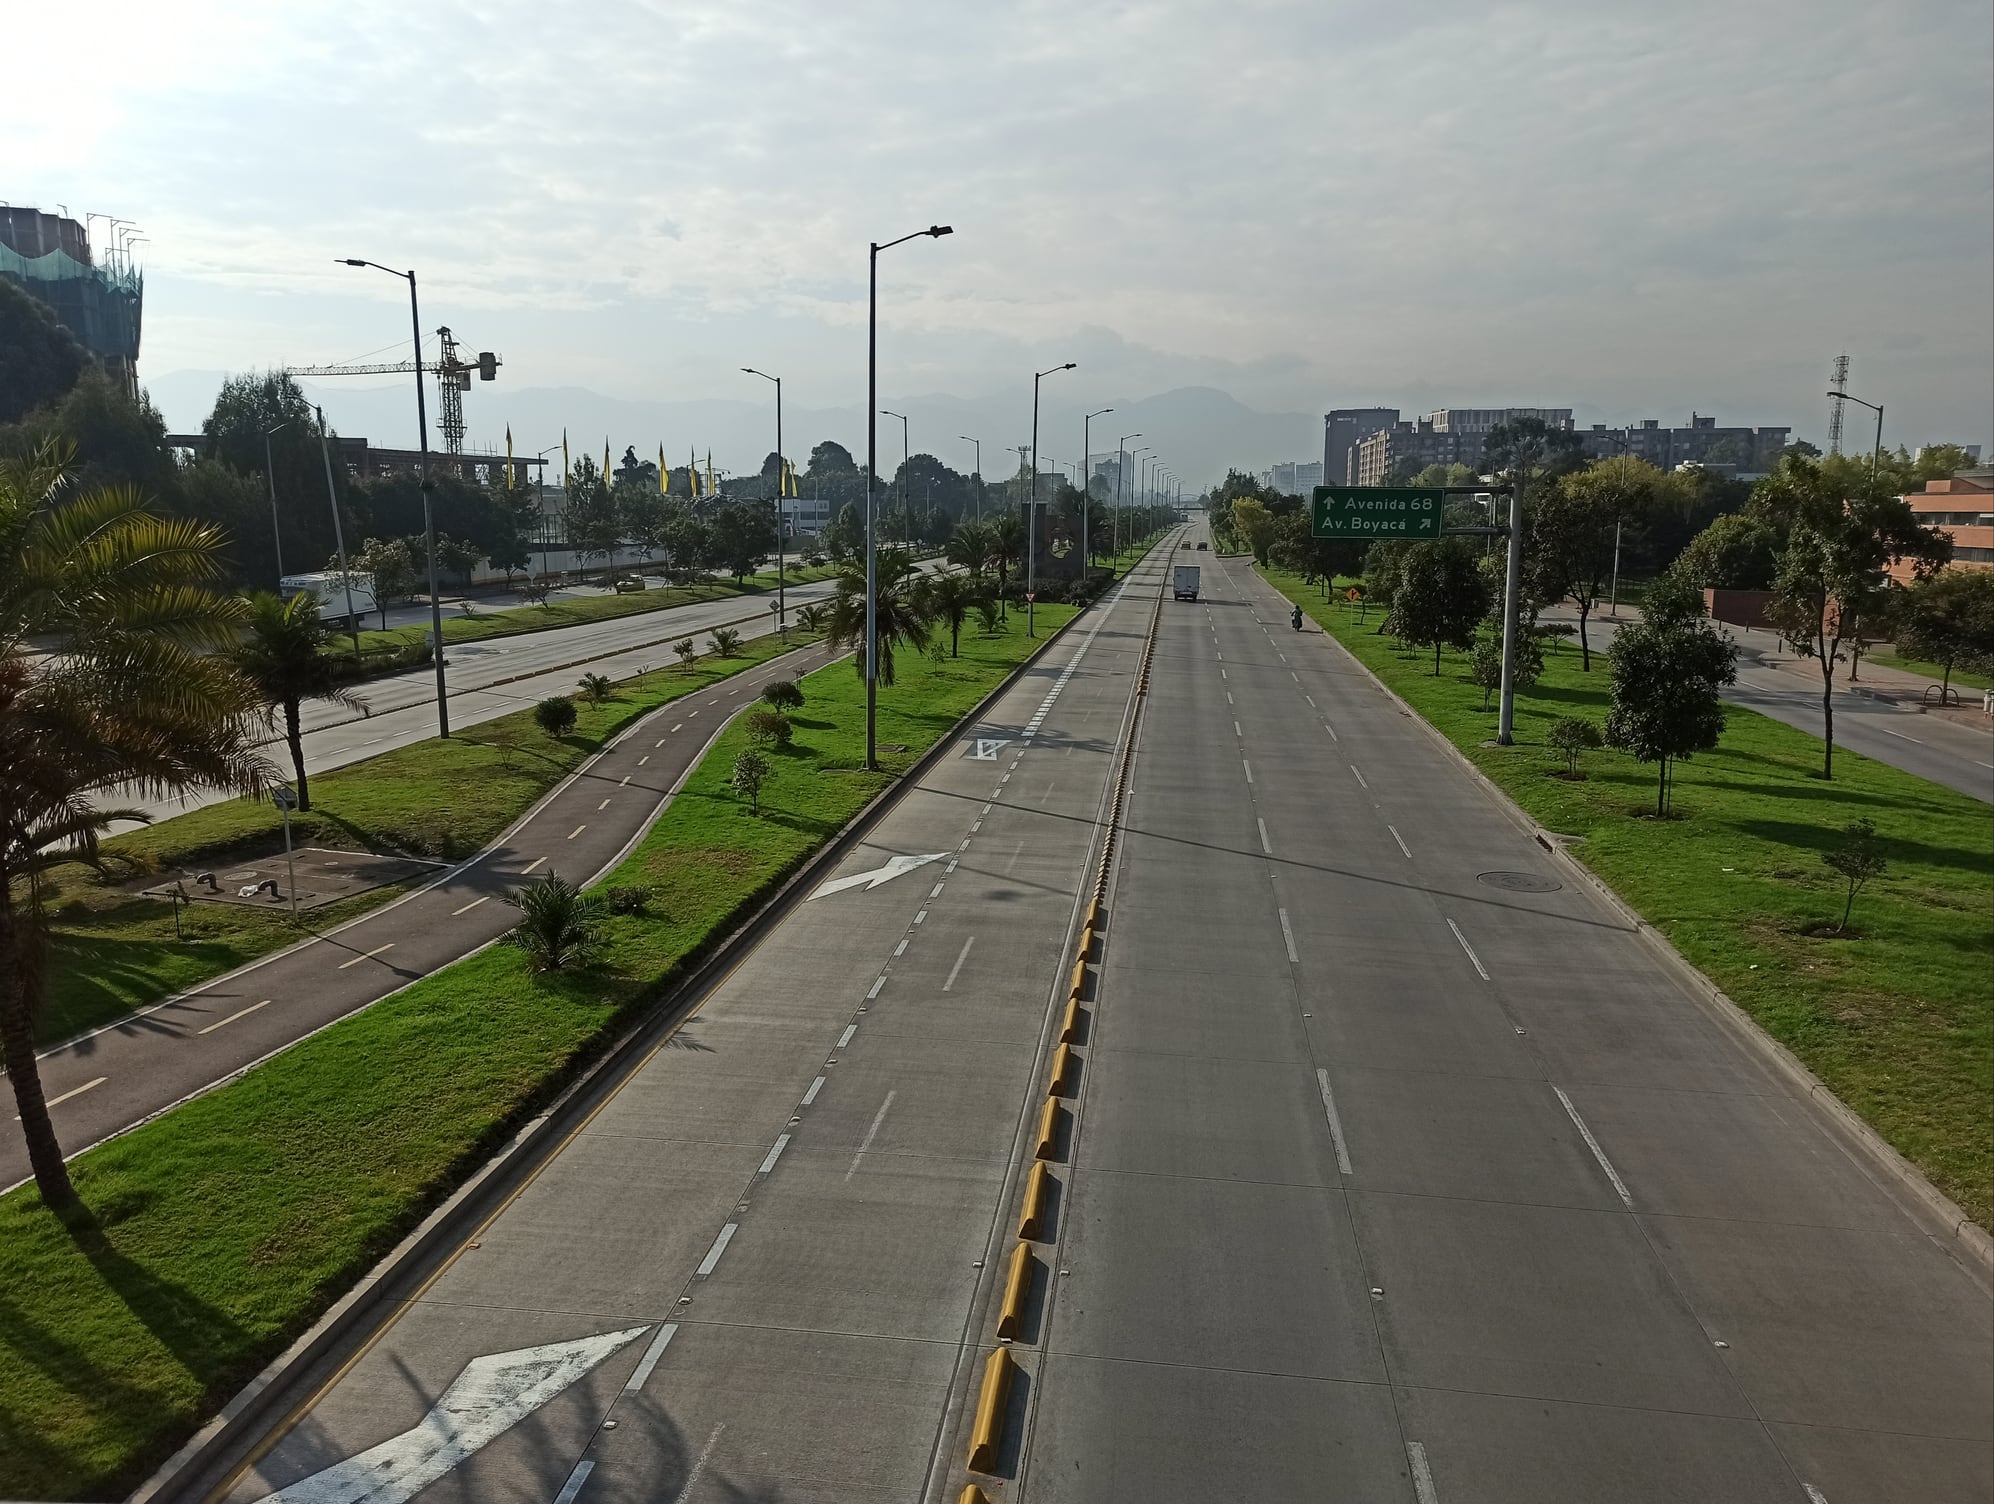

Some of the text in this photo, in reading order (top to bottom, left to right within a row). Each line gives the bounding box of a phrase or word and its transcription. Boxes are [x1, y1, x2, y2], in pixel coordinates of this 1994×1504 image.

[1344, 497, 1433, 510] Avenida 68
[1321, 516, 1406, 532] Av. Boyacá
